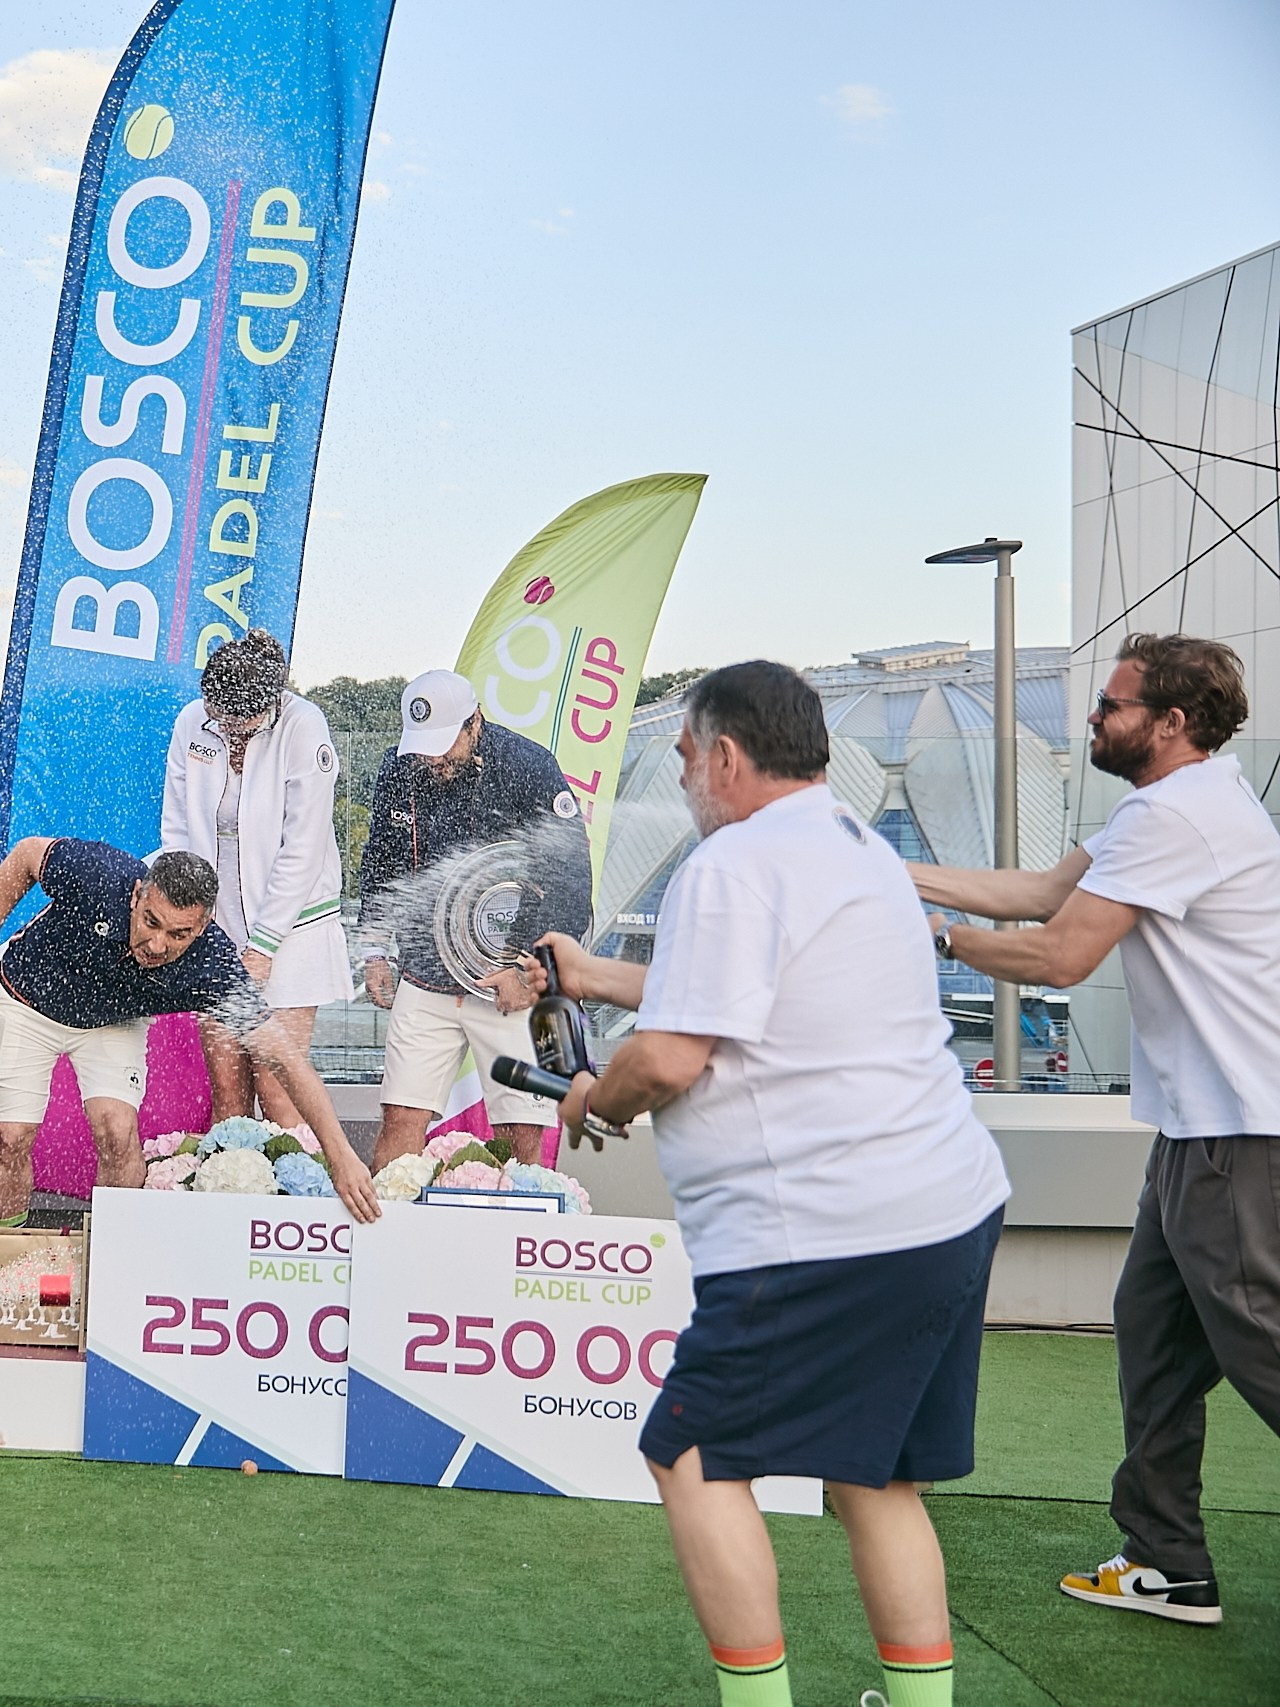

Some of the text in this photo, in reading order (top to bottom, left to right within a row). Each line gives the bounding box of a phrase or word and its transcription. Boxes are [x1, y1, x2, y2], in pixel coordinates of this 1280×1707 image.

[50, 176, 212, 661] BOSCO
[194, 187, 317, 671] PADEL CUP
[571, 636, 625, 744] CUP
[189, 741, 217, 758] BOSCO
[616, 913, 645, 925] ВХОД
[645, 913, 656, 924] 11
[250, 1219, 352, 1254] BOSC
[249, 1260, 323, 1283] PADEL
[516, 1236, 653, 1275] BOSCO
[514, 1278, 652, 1306] PADEL CUP
[142, 1295, 289, 1360] 250
[405, 1311, 556, 1380] 250
[523, 1394, 637, 1421] БОНУСОВ
